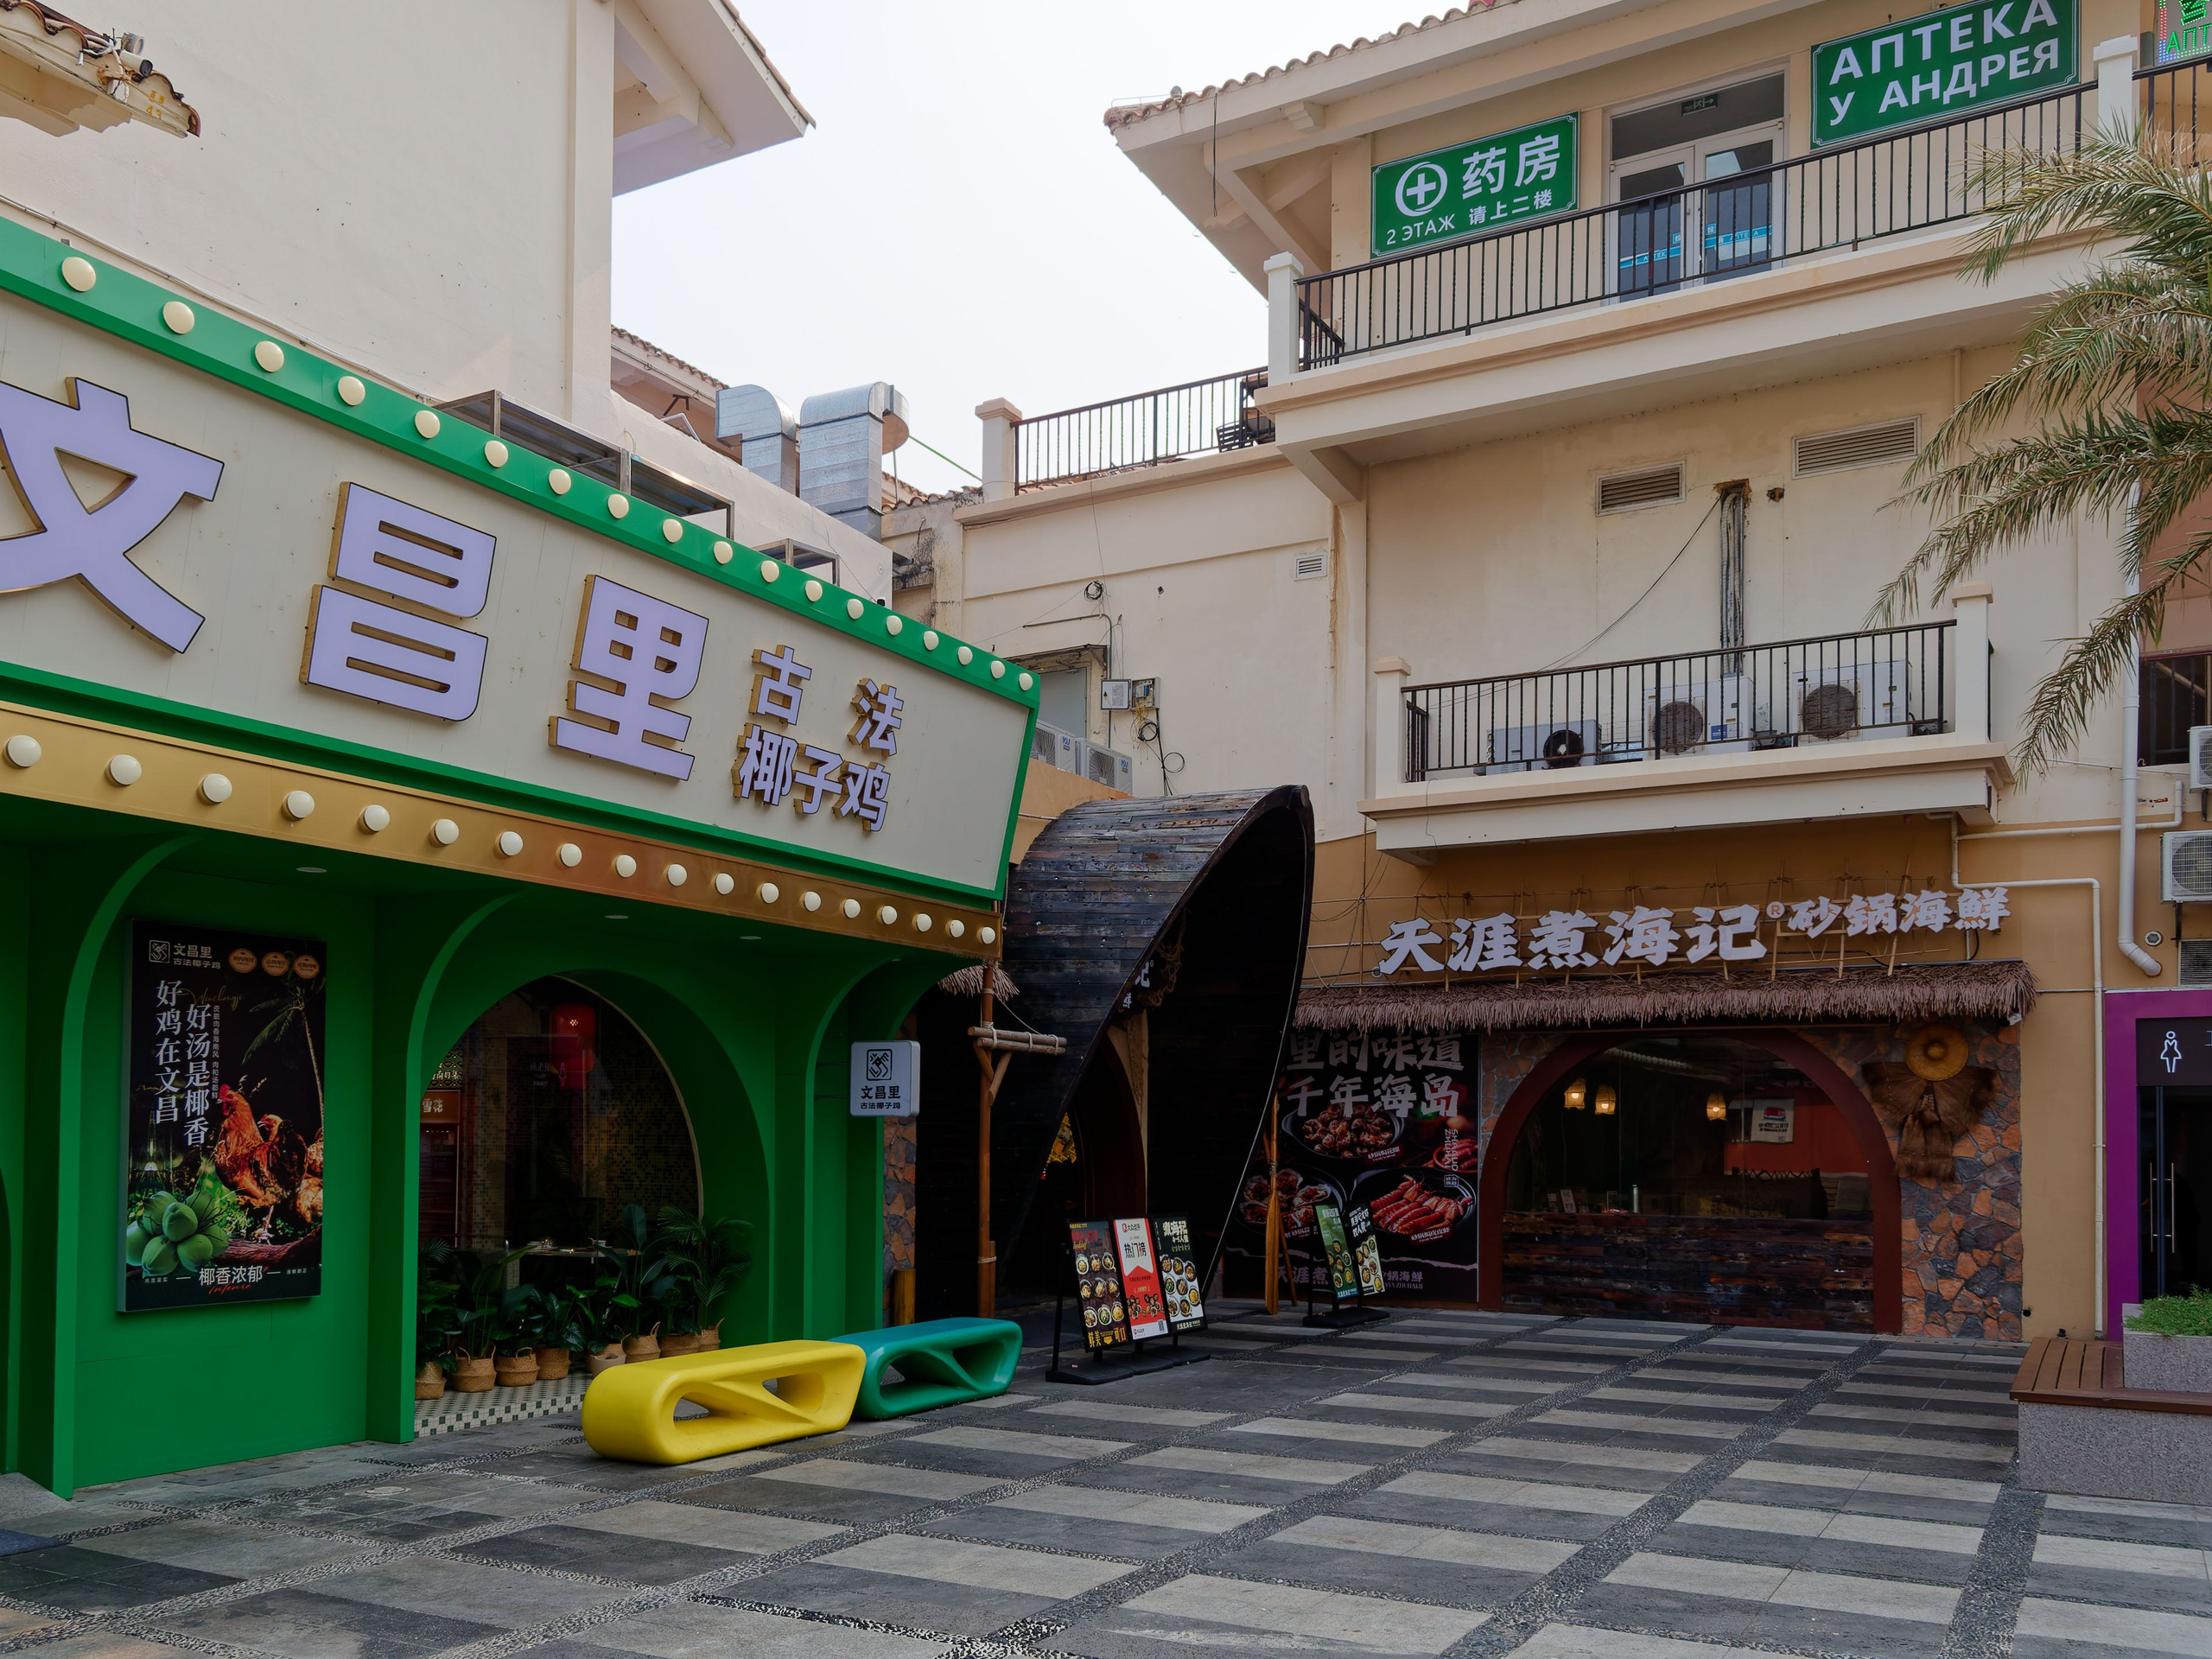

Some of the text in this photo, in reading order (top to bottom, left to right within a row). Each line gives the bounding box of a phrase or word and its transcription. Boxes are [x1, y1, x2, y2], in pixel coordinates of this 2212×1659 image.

[1829, 0, 2058, 86] АПТЕКА
[1829, 37, 2059, 126] У АНДРЕЯ
[1462, 134, 1560, 200] 药房
[1386, 213, 1455, 245] 2 ЭТАЖ
[1469, 188, 1552, 226] 请上二楼
[0, 377, 710, 782] 文昌里
[732, 722, 891, 832] 椰子鸡
[173, 943, 213, 959] 文昌里
[1379, 887, 2012, 976] 天涯煮海记 砂锅海鲜
[173, 957, 221, 969] 古法椰子鸡
[154, 980, 182, 1124] 好鸡在文昌
[184, 1003, 212, 1147] 好汤是椰香
[1287, 1031, 1465, 1071] 里的味道
[861, 1085, 900, 1099] 文昌里
[1287, 1073, 1460, 1117] 千年海岛
[199, 1265, 263, 1286] 椰香浓郁
